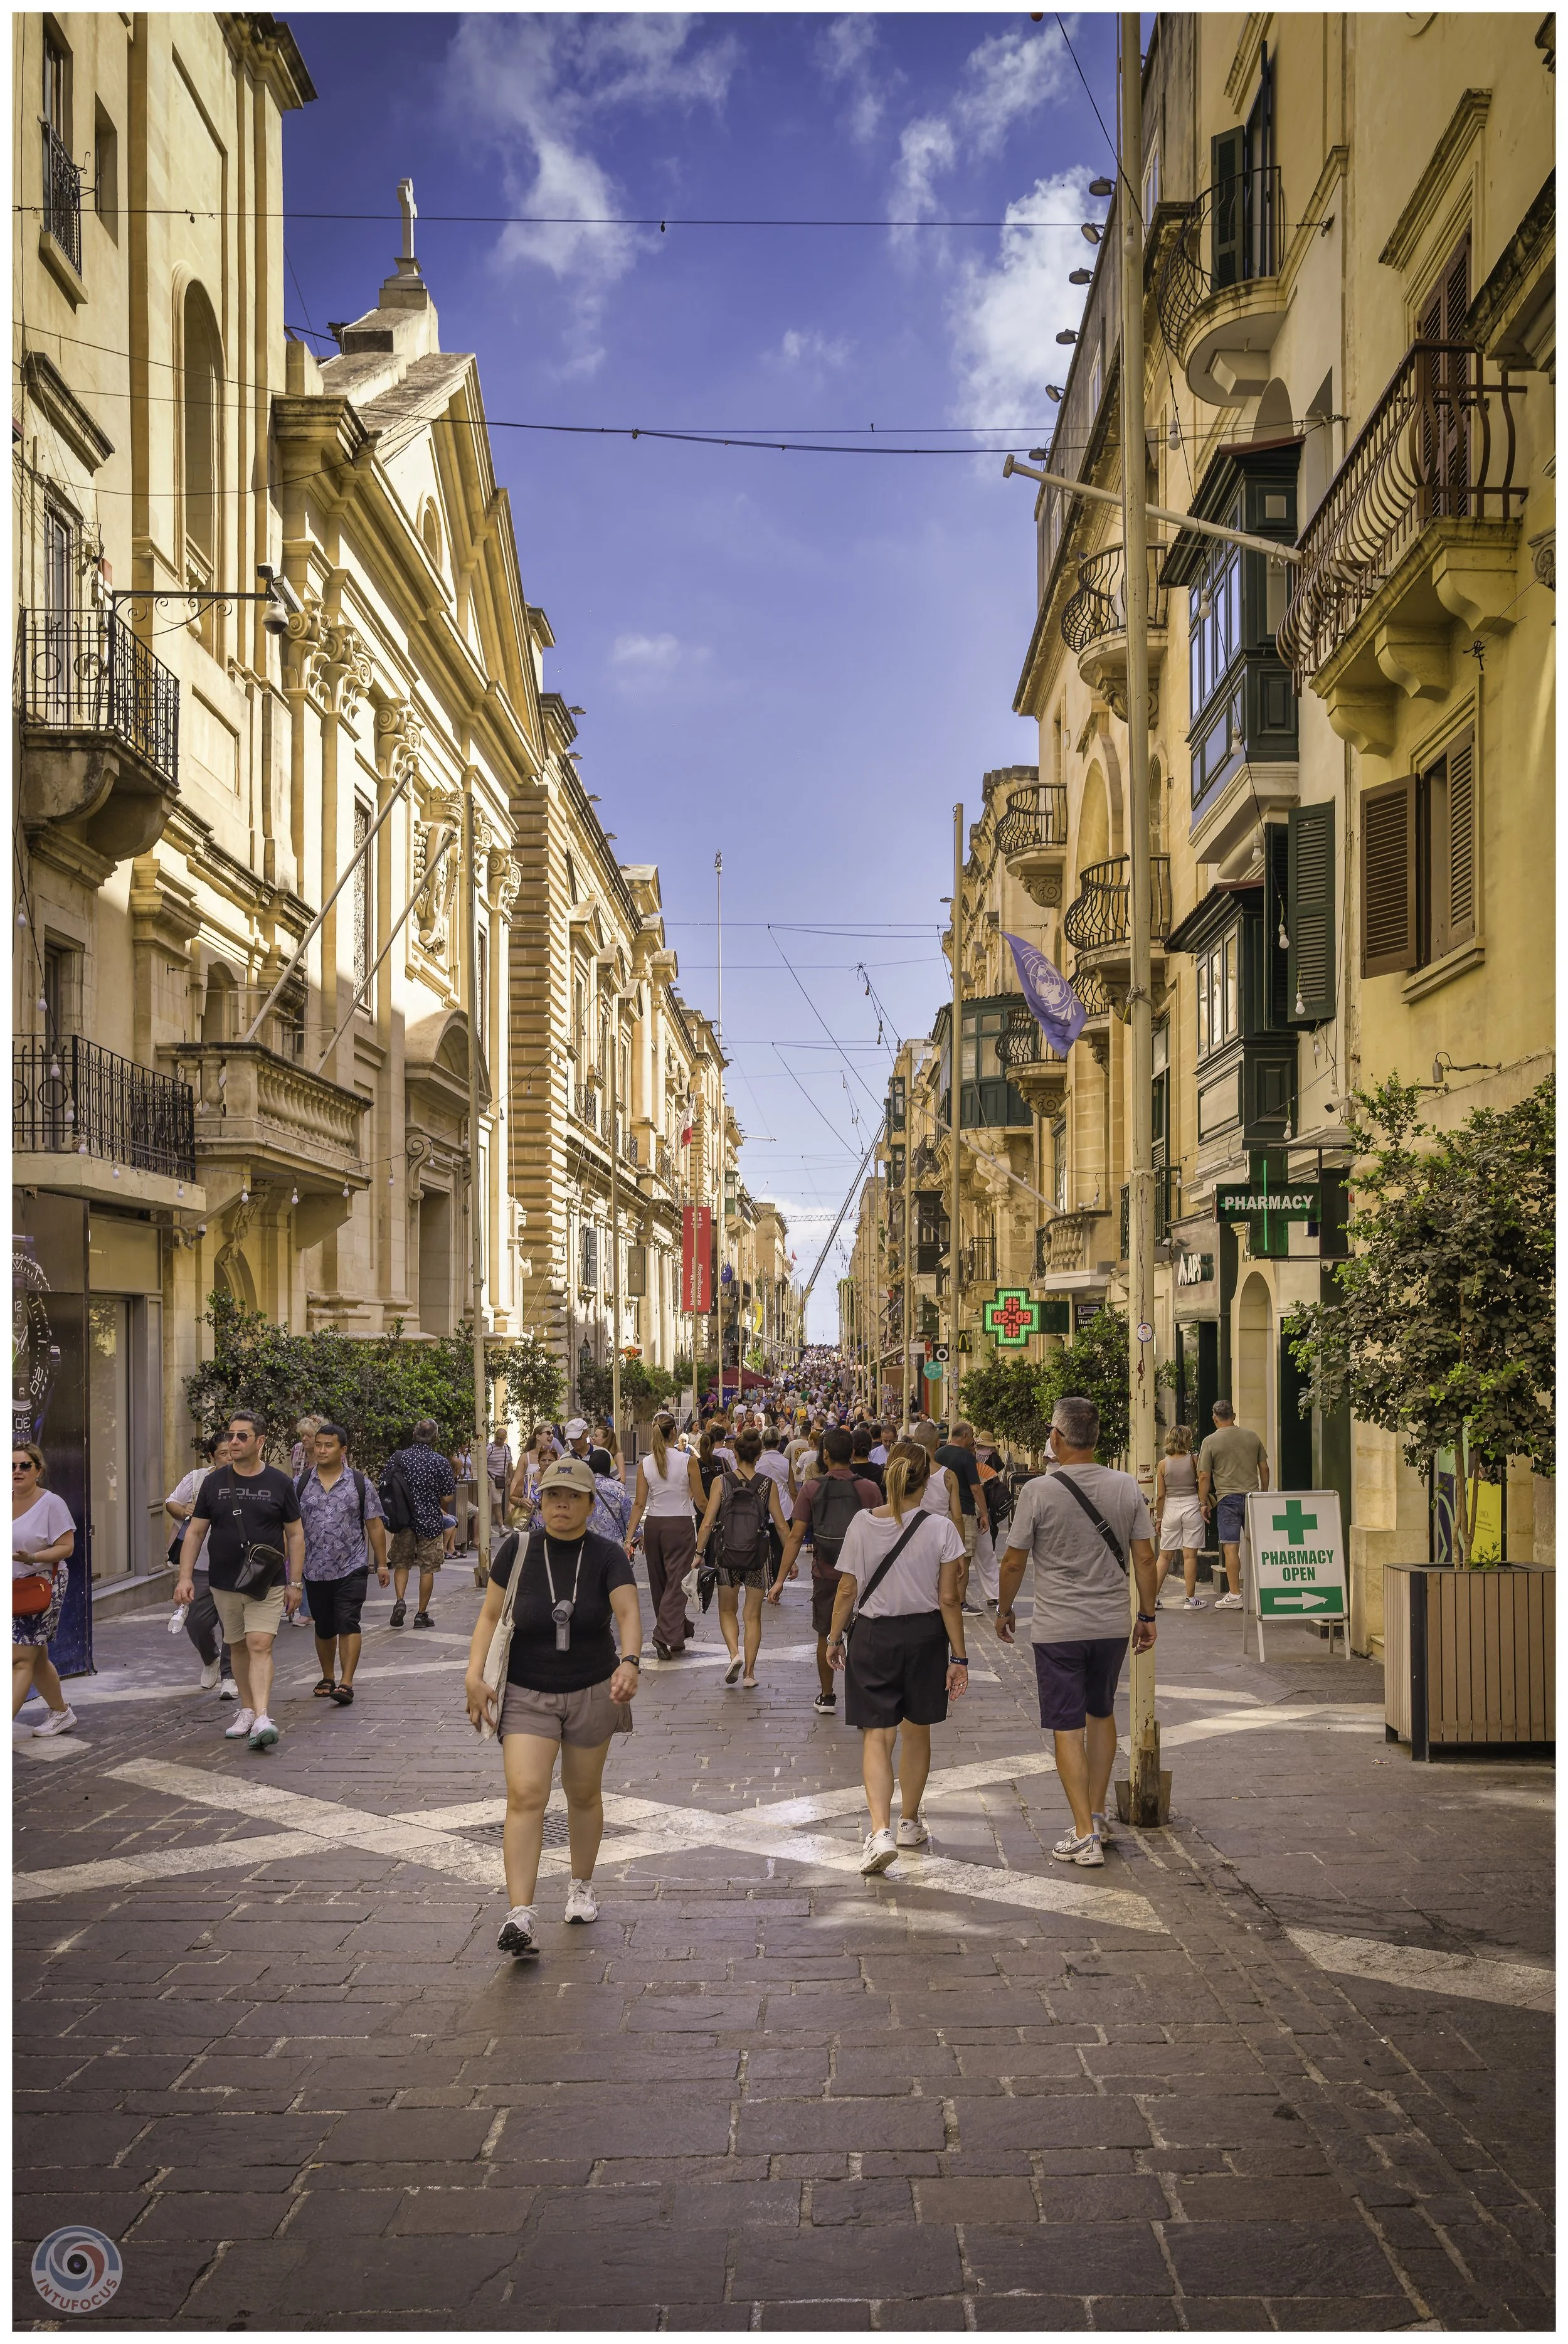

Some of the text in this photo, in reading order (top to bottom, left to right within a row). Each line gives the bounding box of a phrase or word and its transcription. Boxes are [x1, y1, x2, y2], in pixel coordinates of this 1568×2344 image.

[1224, 1195, 1313, 1211] PHARMACY
[1187, 1253, 1202, 1283] APS
[993, 1311, 1031, 1324] 02-09
[218, 1488, 271, 1498] POLO
[1261, 1549, 1334, 1566] PHARMACY
[1282, 1566, 1316, 1581] OPEN
